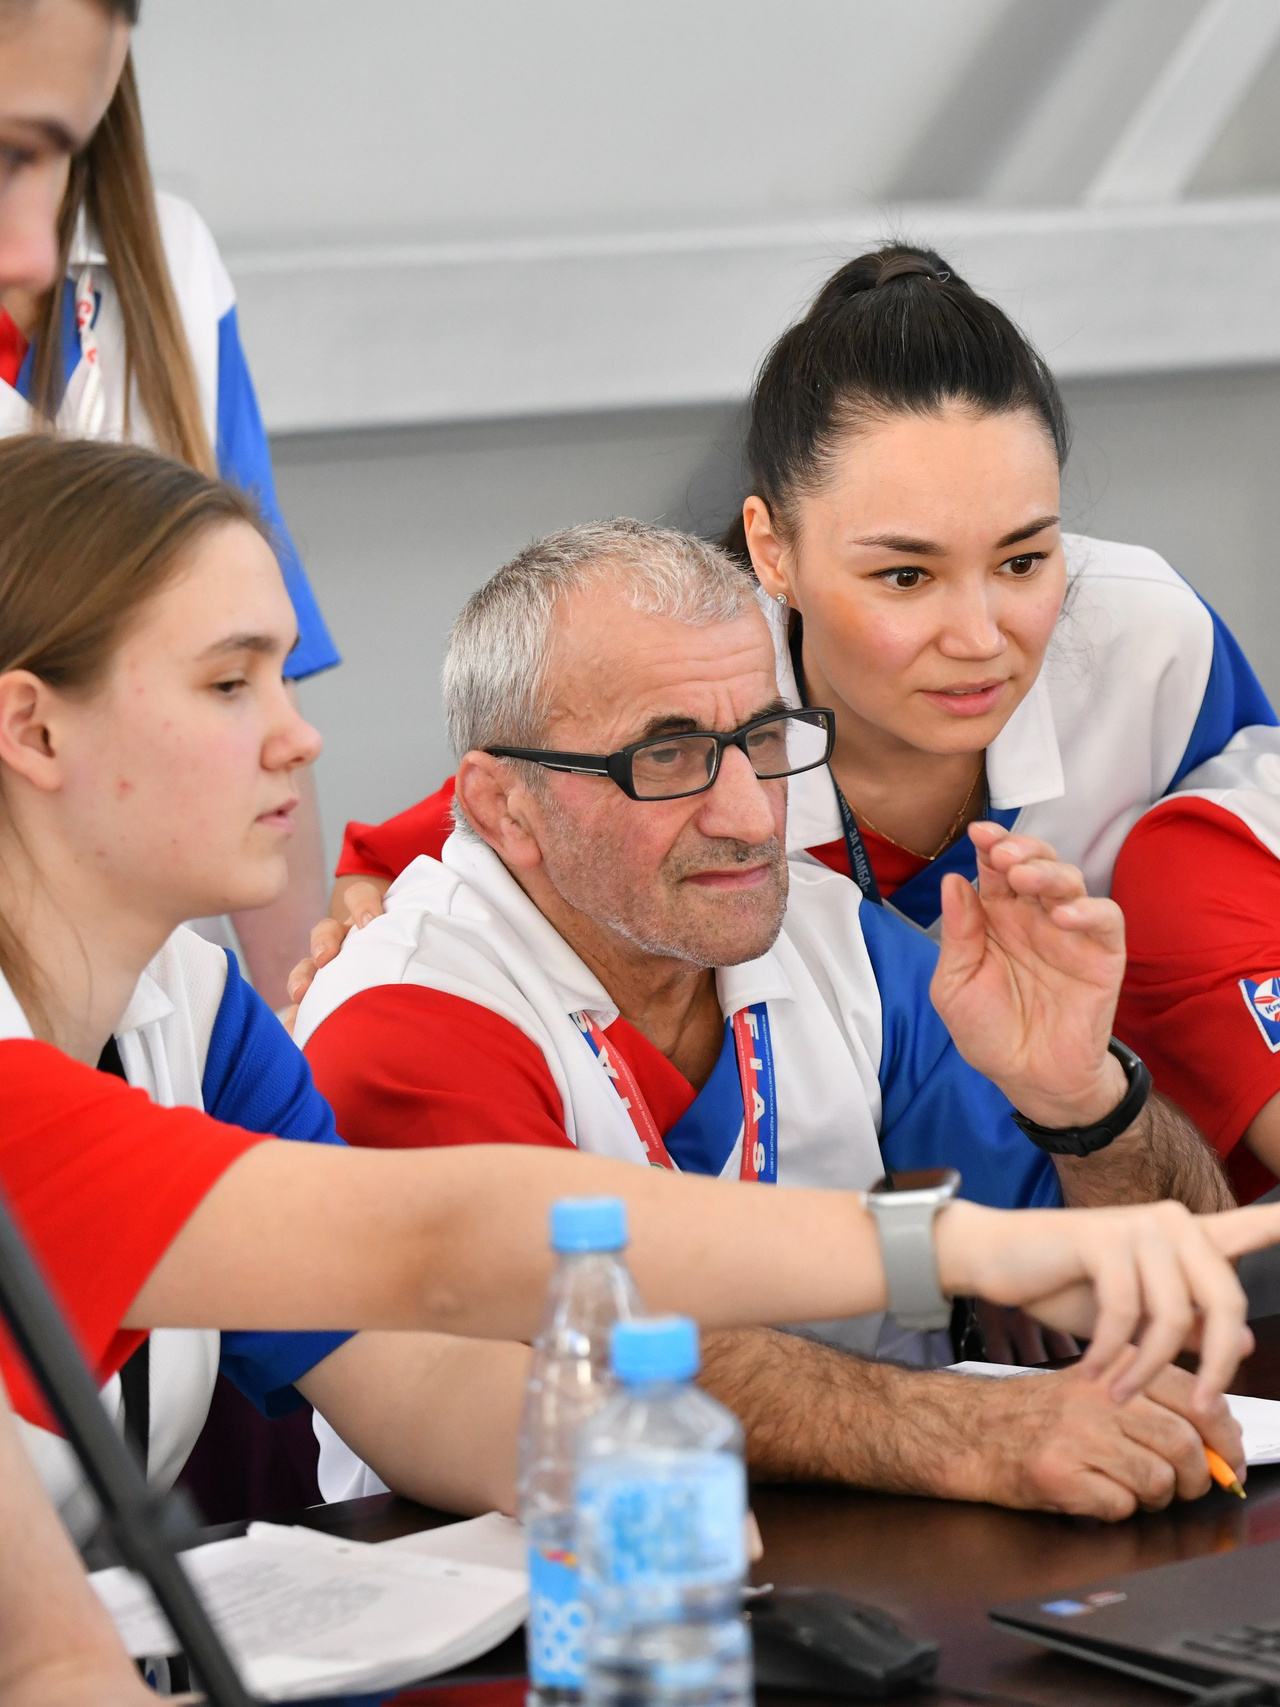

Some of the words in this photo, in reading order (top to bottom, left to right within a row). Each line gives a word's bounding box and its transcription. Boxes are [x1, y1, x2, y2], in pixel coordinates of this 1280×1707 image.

[849, 827, 860, 846] ЗА
[853, 844, 871, 887] САМБО
[743, 1012, 766, 1173] FIAS
